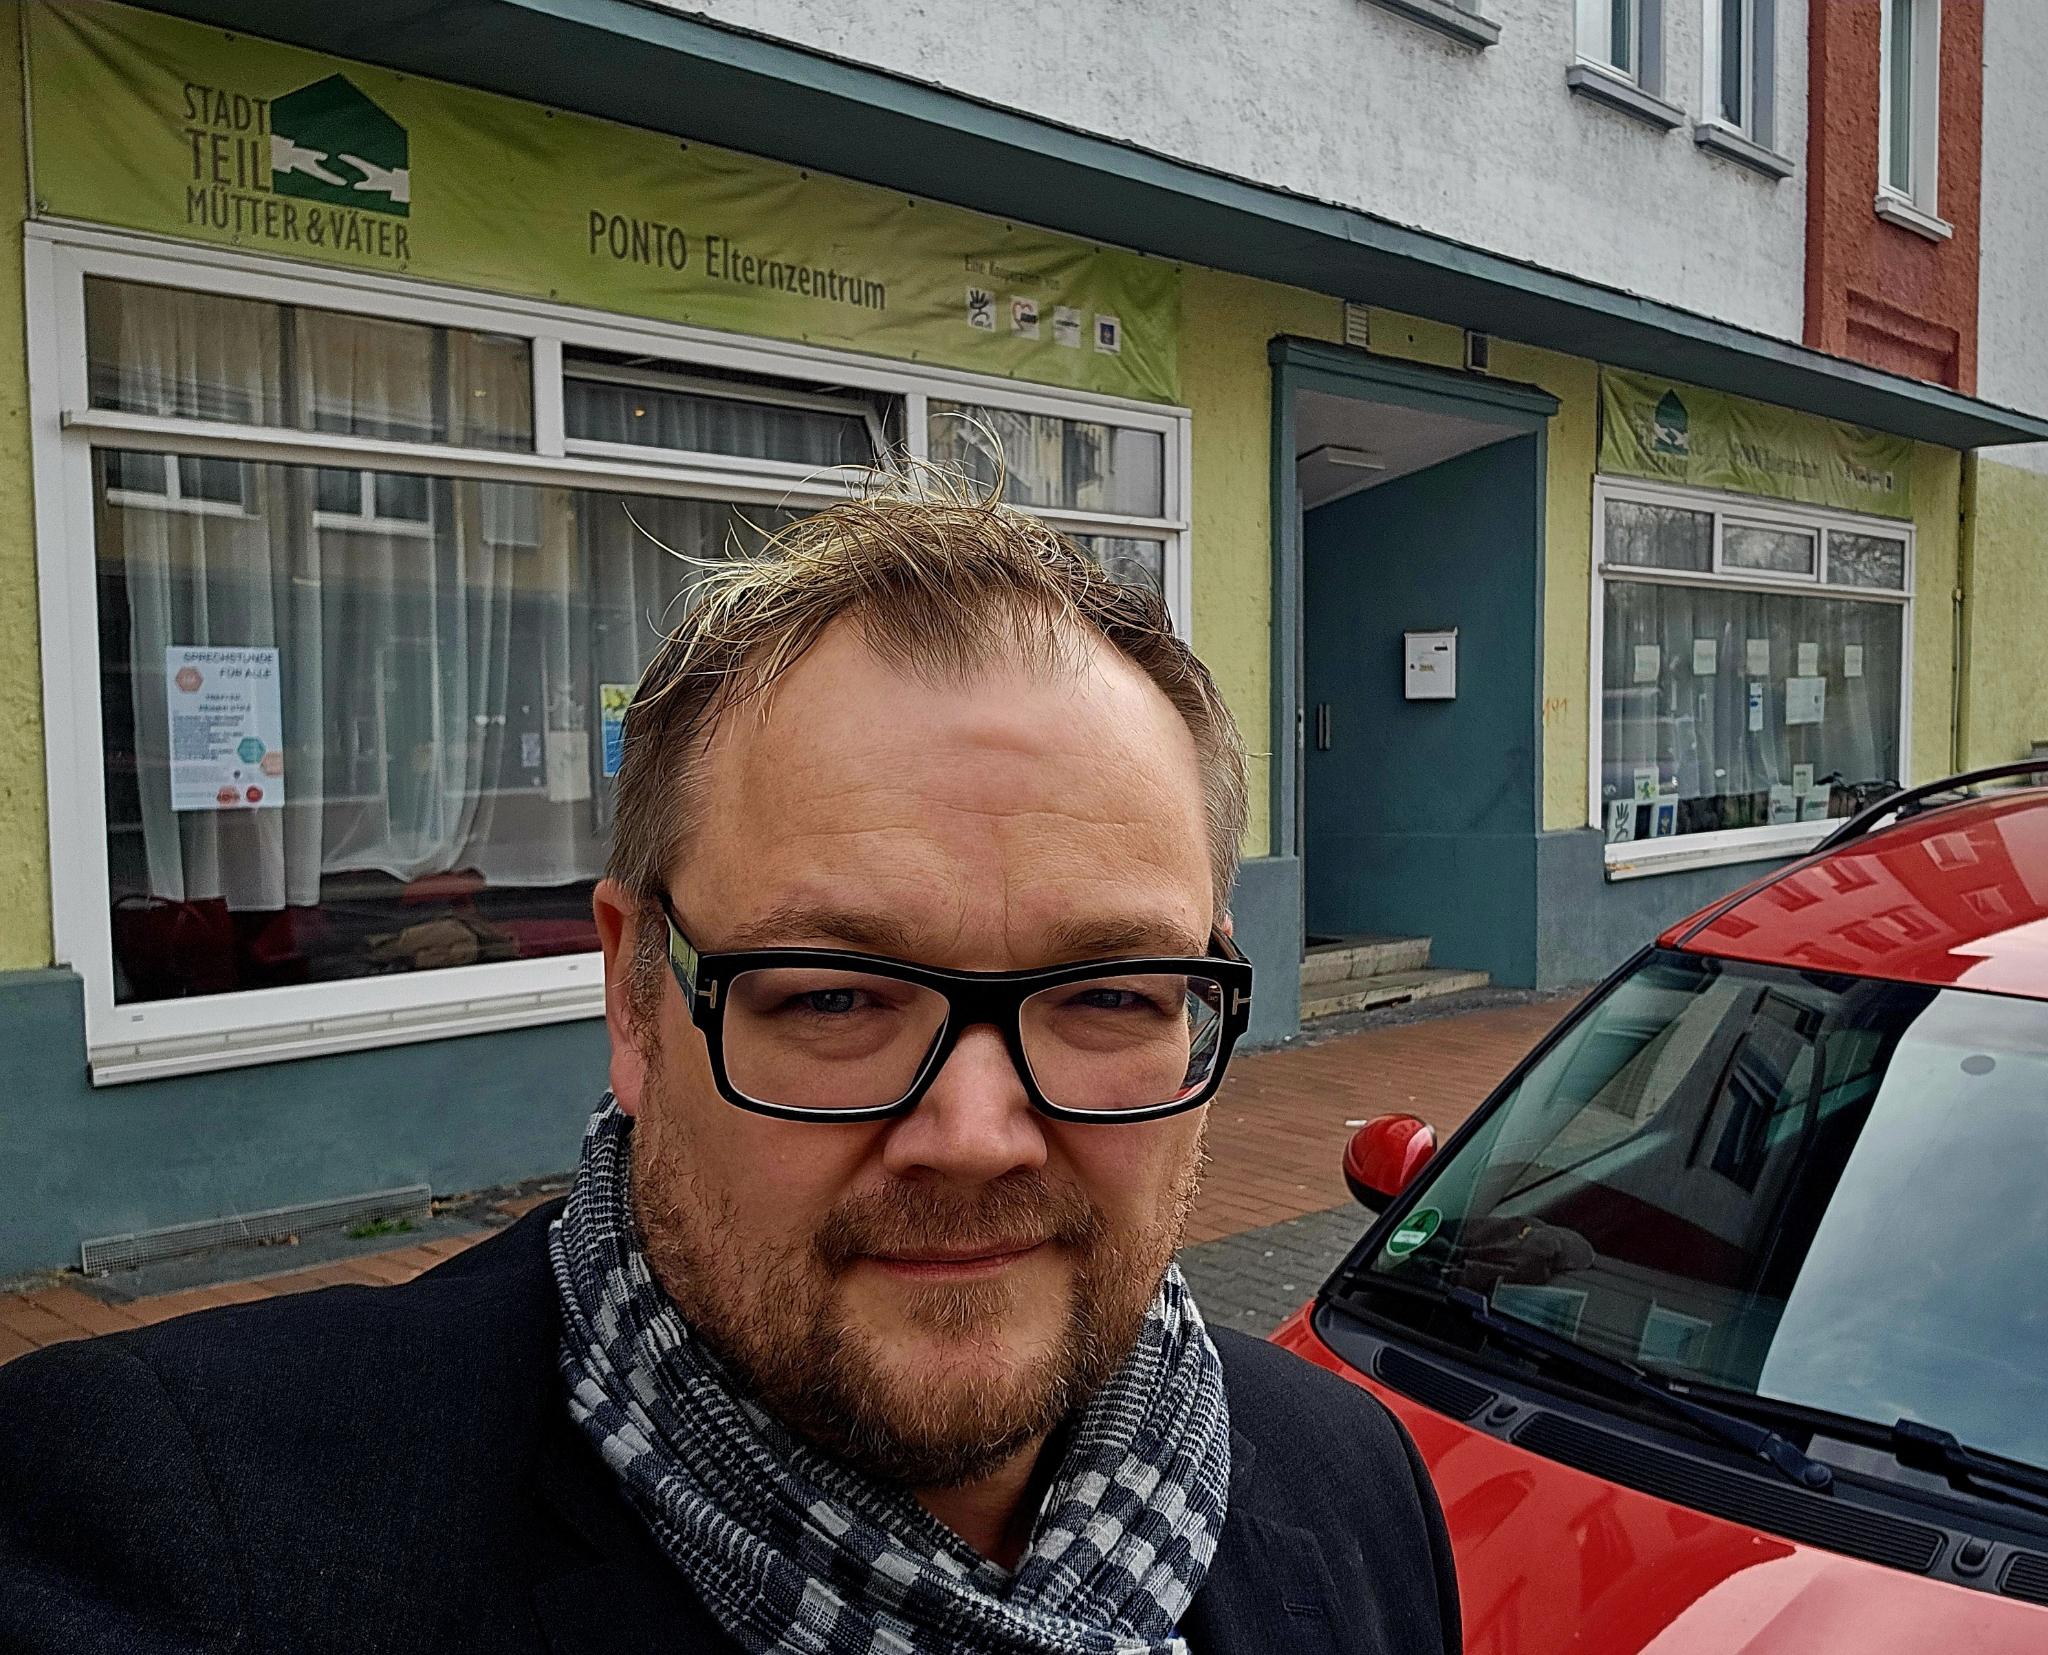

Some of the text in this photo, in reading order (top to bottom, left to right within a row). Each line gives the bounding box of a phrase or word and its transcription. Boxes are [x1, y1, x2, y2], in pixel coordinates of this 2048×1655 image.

[184, 82, 269, 135] STADT
[185, 128, 271, 193] TEIL
[186, 183, 299, 242] MÜTTER
[329, 209, 412, 260] VÄTER
[589, 209, 886, 311] PONTO Elternzentrum
